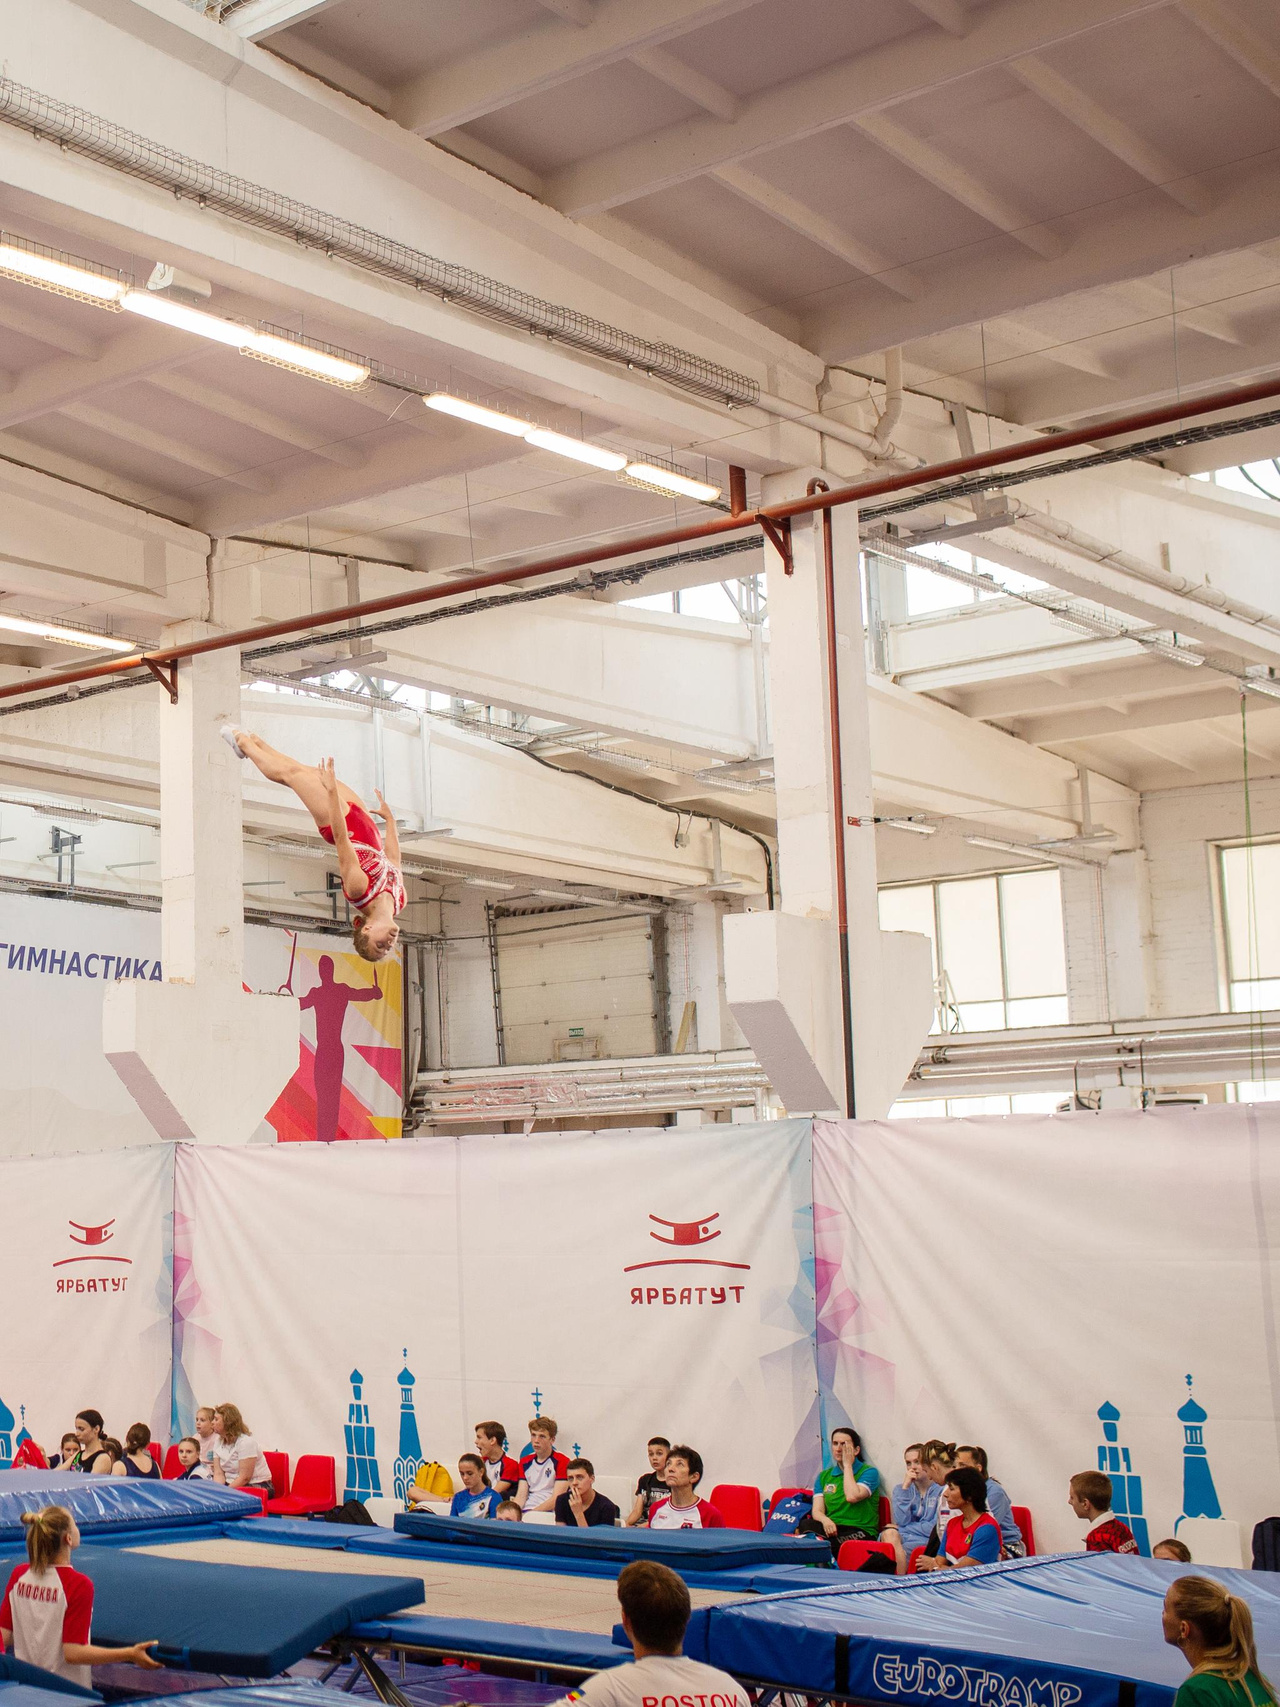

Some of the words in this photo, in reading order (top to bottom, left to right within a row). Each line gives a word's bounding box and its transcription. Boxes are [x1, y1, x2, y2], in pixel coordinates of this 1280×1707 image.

[56, 1277, 129, 1294] ЯРБАТУТ
[630, 1286, 746, 1305] ЯРБАТУТ
[17, 1582, 59, 1603] МОСКВА
[873, 1653, 1082, 1707] EUROTRAMP
